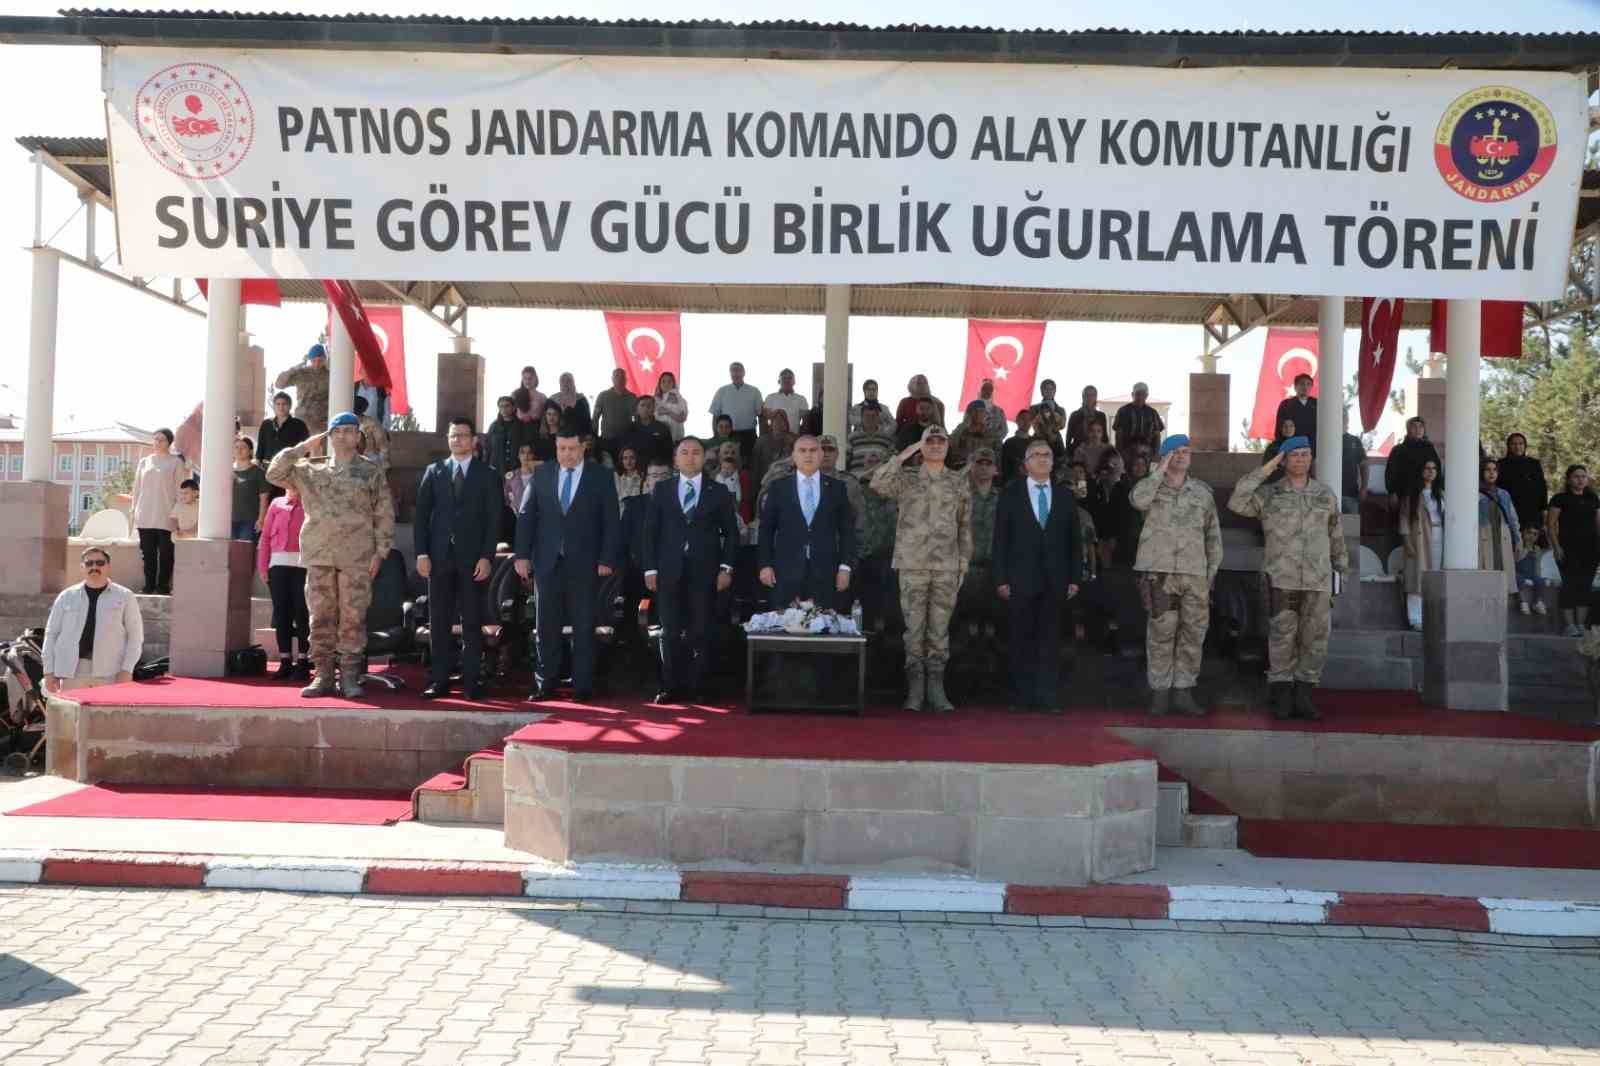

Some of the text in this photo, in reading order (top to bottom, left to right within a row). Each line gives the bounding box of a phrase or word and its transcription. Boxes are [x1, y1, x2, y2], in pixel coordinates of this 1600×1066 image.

[278, 106, 450, 156] PATNOS
[465, 109, 712, 157] JANDARMA
[727, 112, 957, 160] KOMANDO
[971, 116, 1087, 163] ALAY
[1100, 111, 1412, 173] KOMUTANLIĞI
[1446, 171, 1541, 200] JANDARMA
[155, 181, 1540, 271] SURİYE GÖREV GÜCÜ BİRLİK UĞURLAMA TÖRENİ
